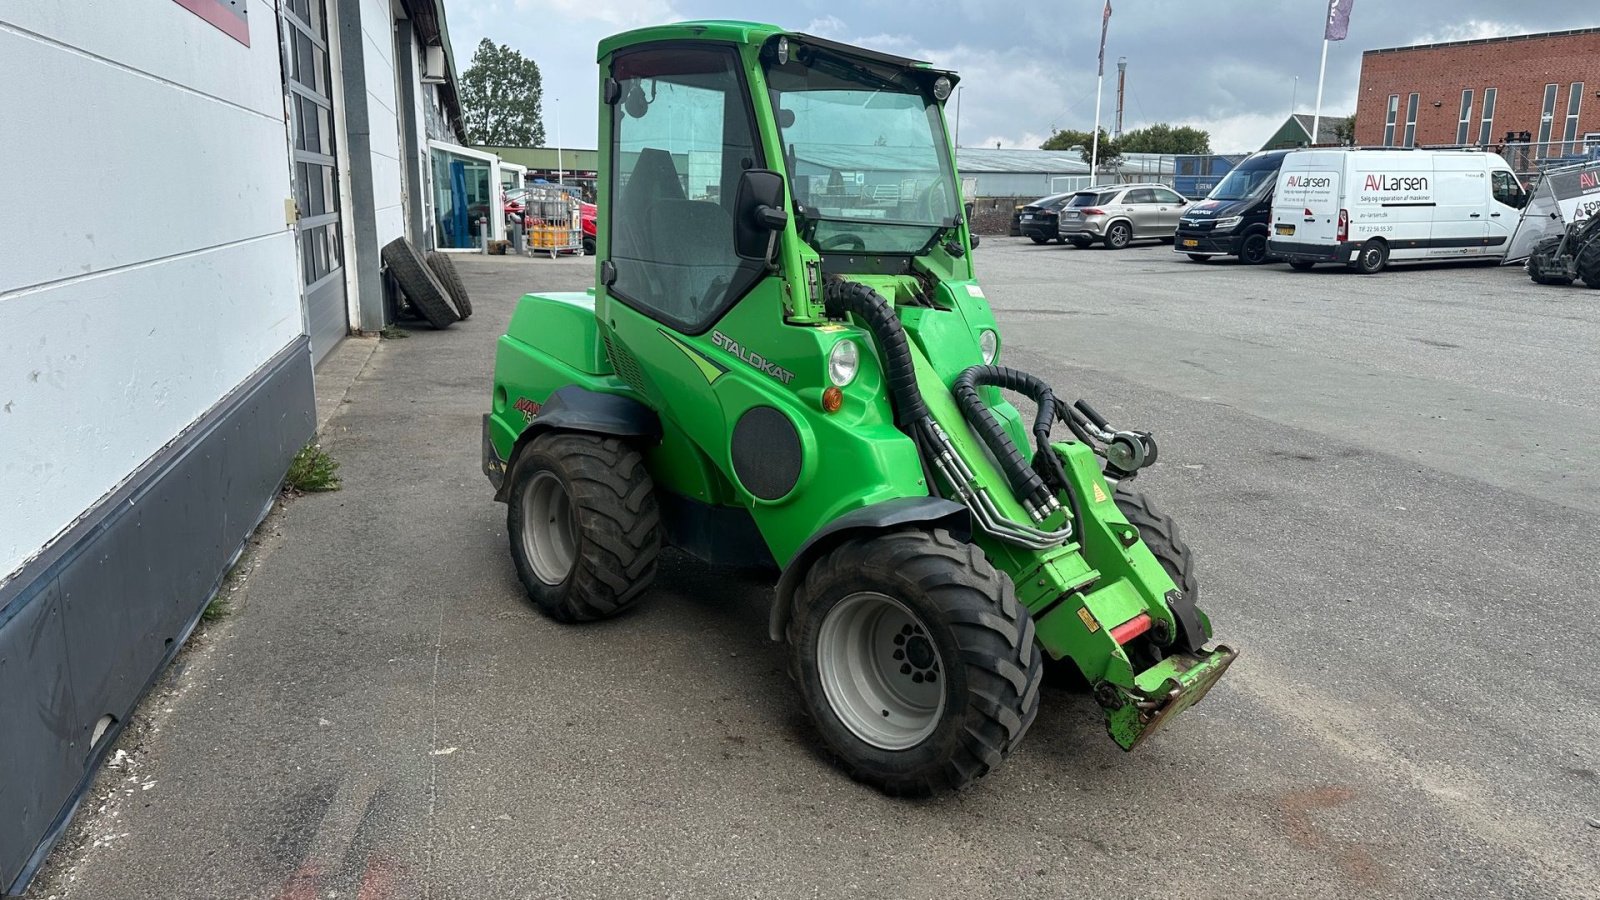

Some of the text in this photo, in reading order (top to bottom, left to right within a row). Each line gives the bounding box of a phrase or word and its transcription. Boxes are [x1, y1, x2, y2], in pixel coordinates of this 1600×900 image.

[1287, 176, 1330, 187] AVLarsen
[1364, 174, 1428, 191] AVLarsen
[711, 330, 795, 384] STALDKAT
